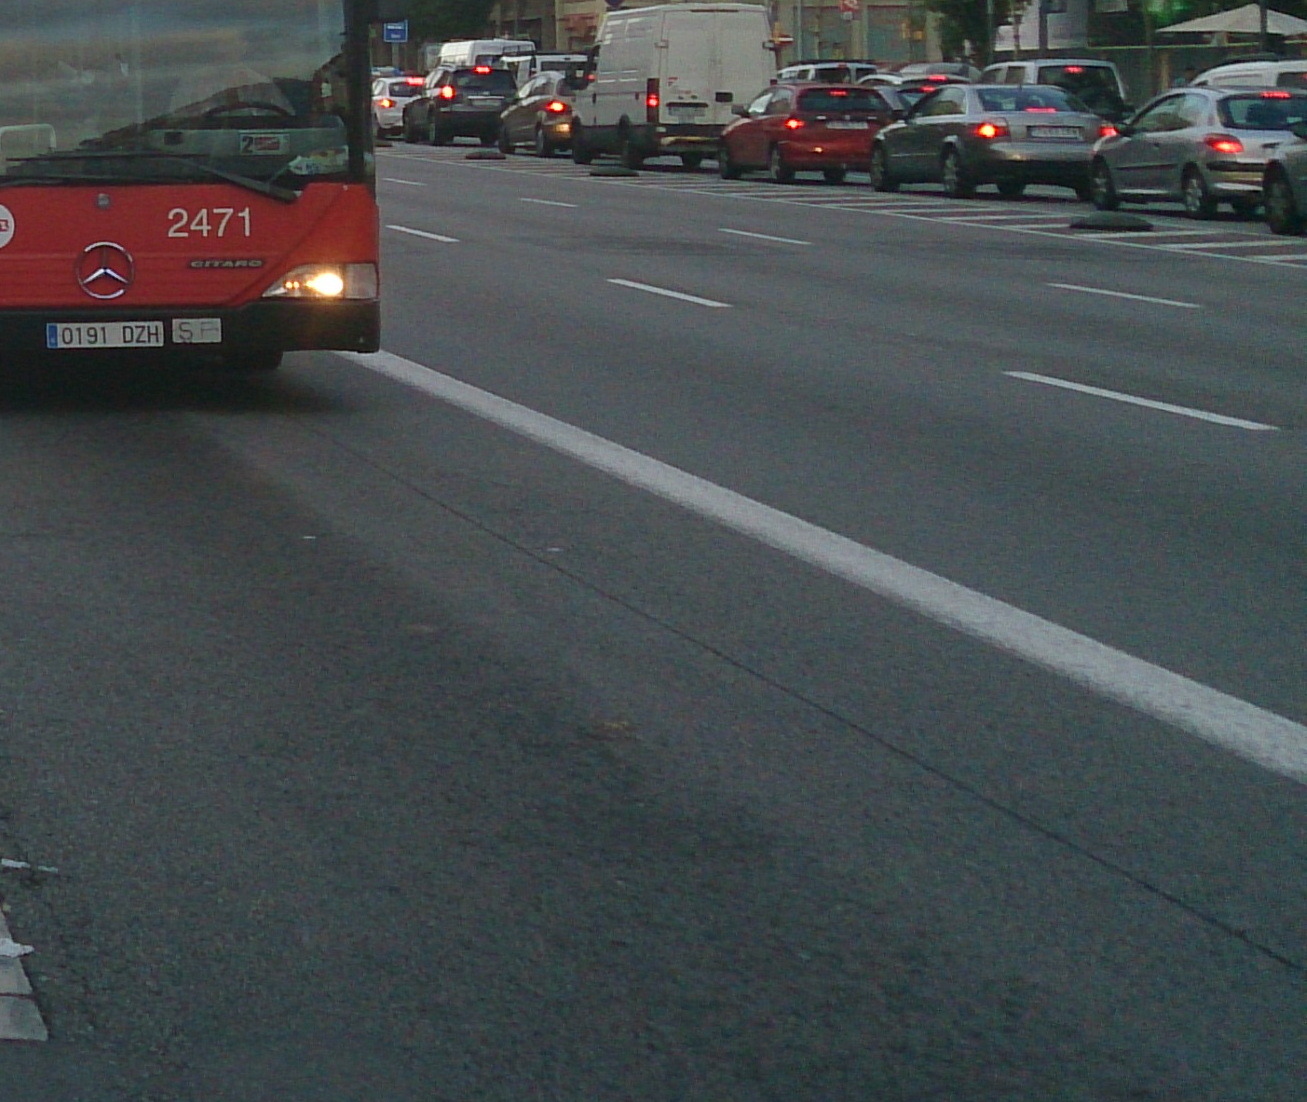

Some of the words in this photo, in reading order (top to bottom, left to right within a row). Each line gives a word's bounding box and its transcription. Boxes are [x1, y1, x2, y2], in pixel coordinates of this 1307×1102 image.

[167, 207, 251, 238] 2471
[189, 259, 263, 268] CITARO
[61, 326, 108, 346] 0191
[122, 325, 160, 344] DZH
